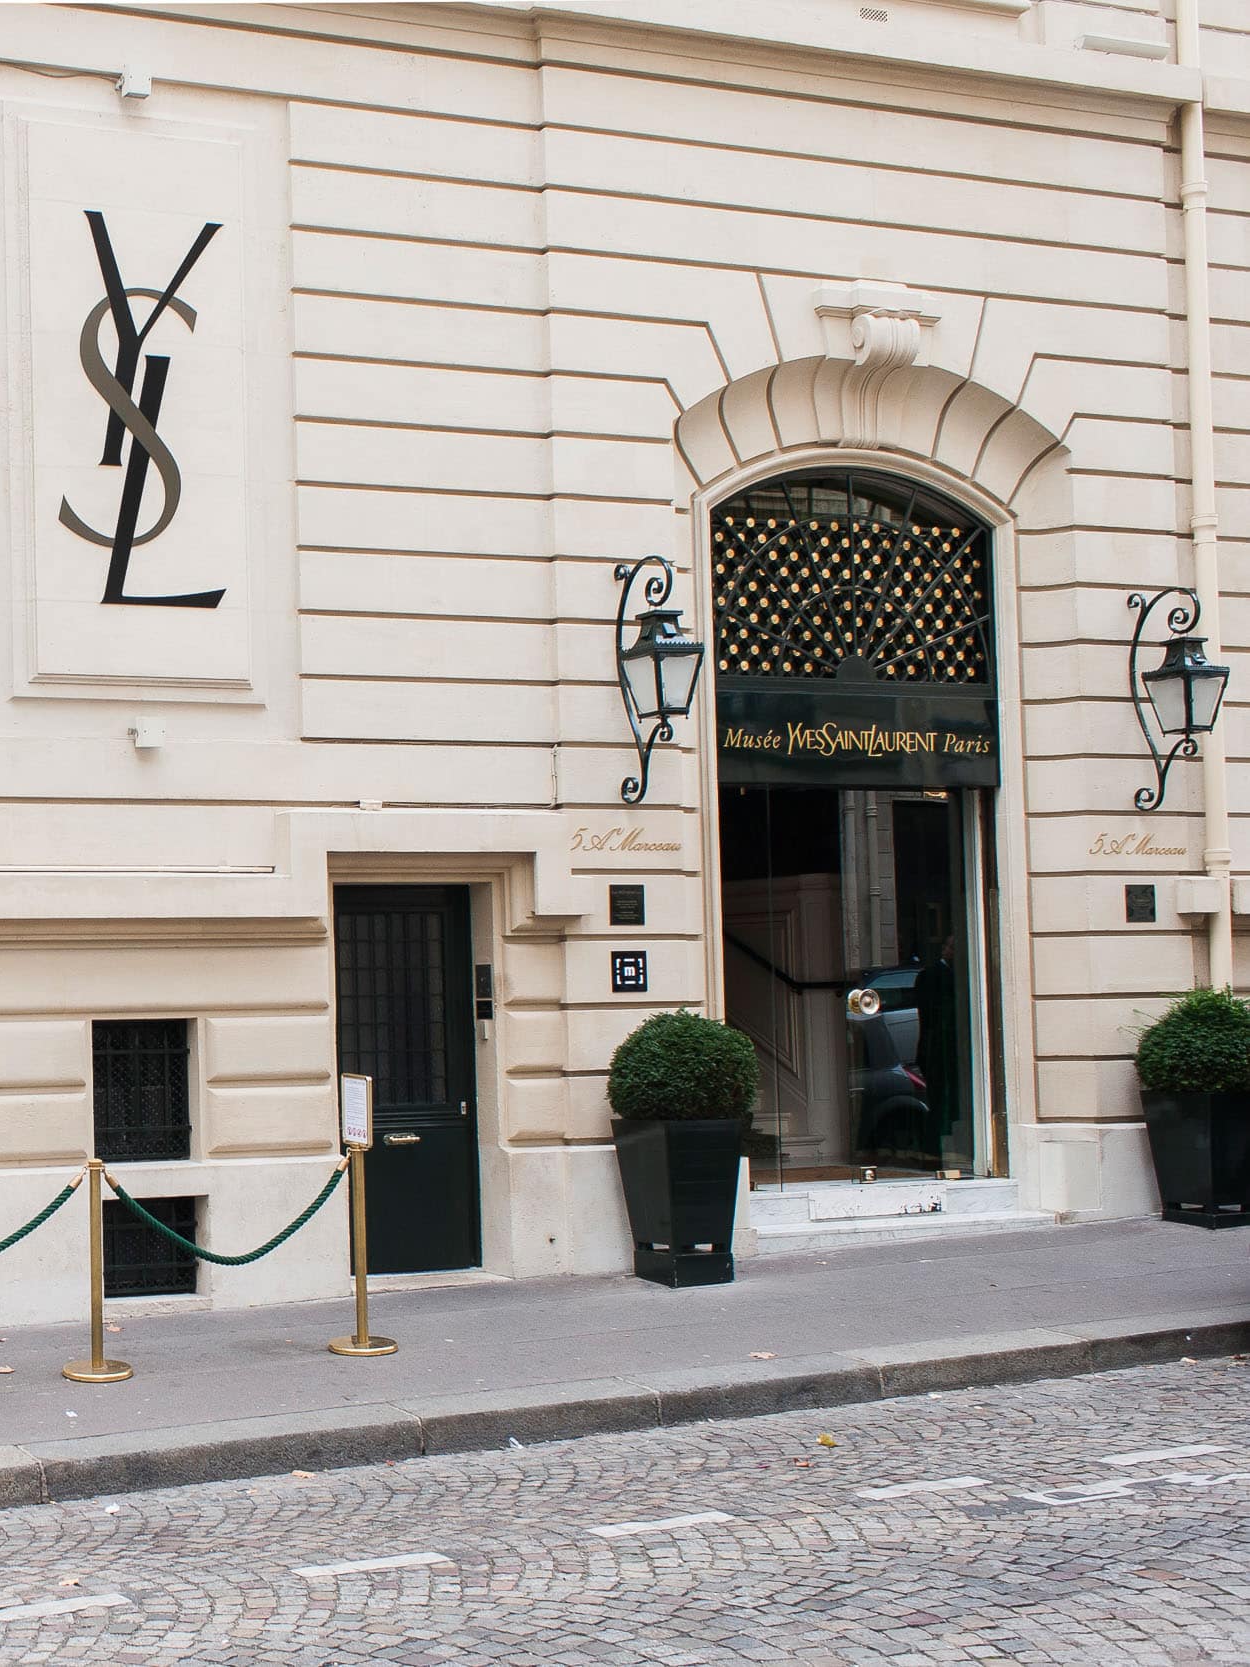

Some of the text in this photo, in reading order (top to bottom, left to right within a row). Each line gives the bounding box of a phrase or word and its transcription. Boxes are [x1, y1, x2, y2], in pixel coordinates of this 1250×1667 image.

[723, 728, 781, 749] Musée
[943, 733, 990, 753] Paris
[570, 828, 588, 851] 5
[609, 827, 682, 851] Marceau
[1089, 833, 1108, 855] 5
[1125, 833, 1187, 855] Marceau
